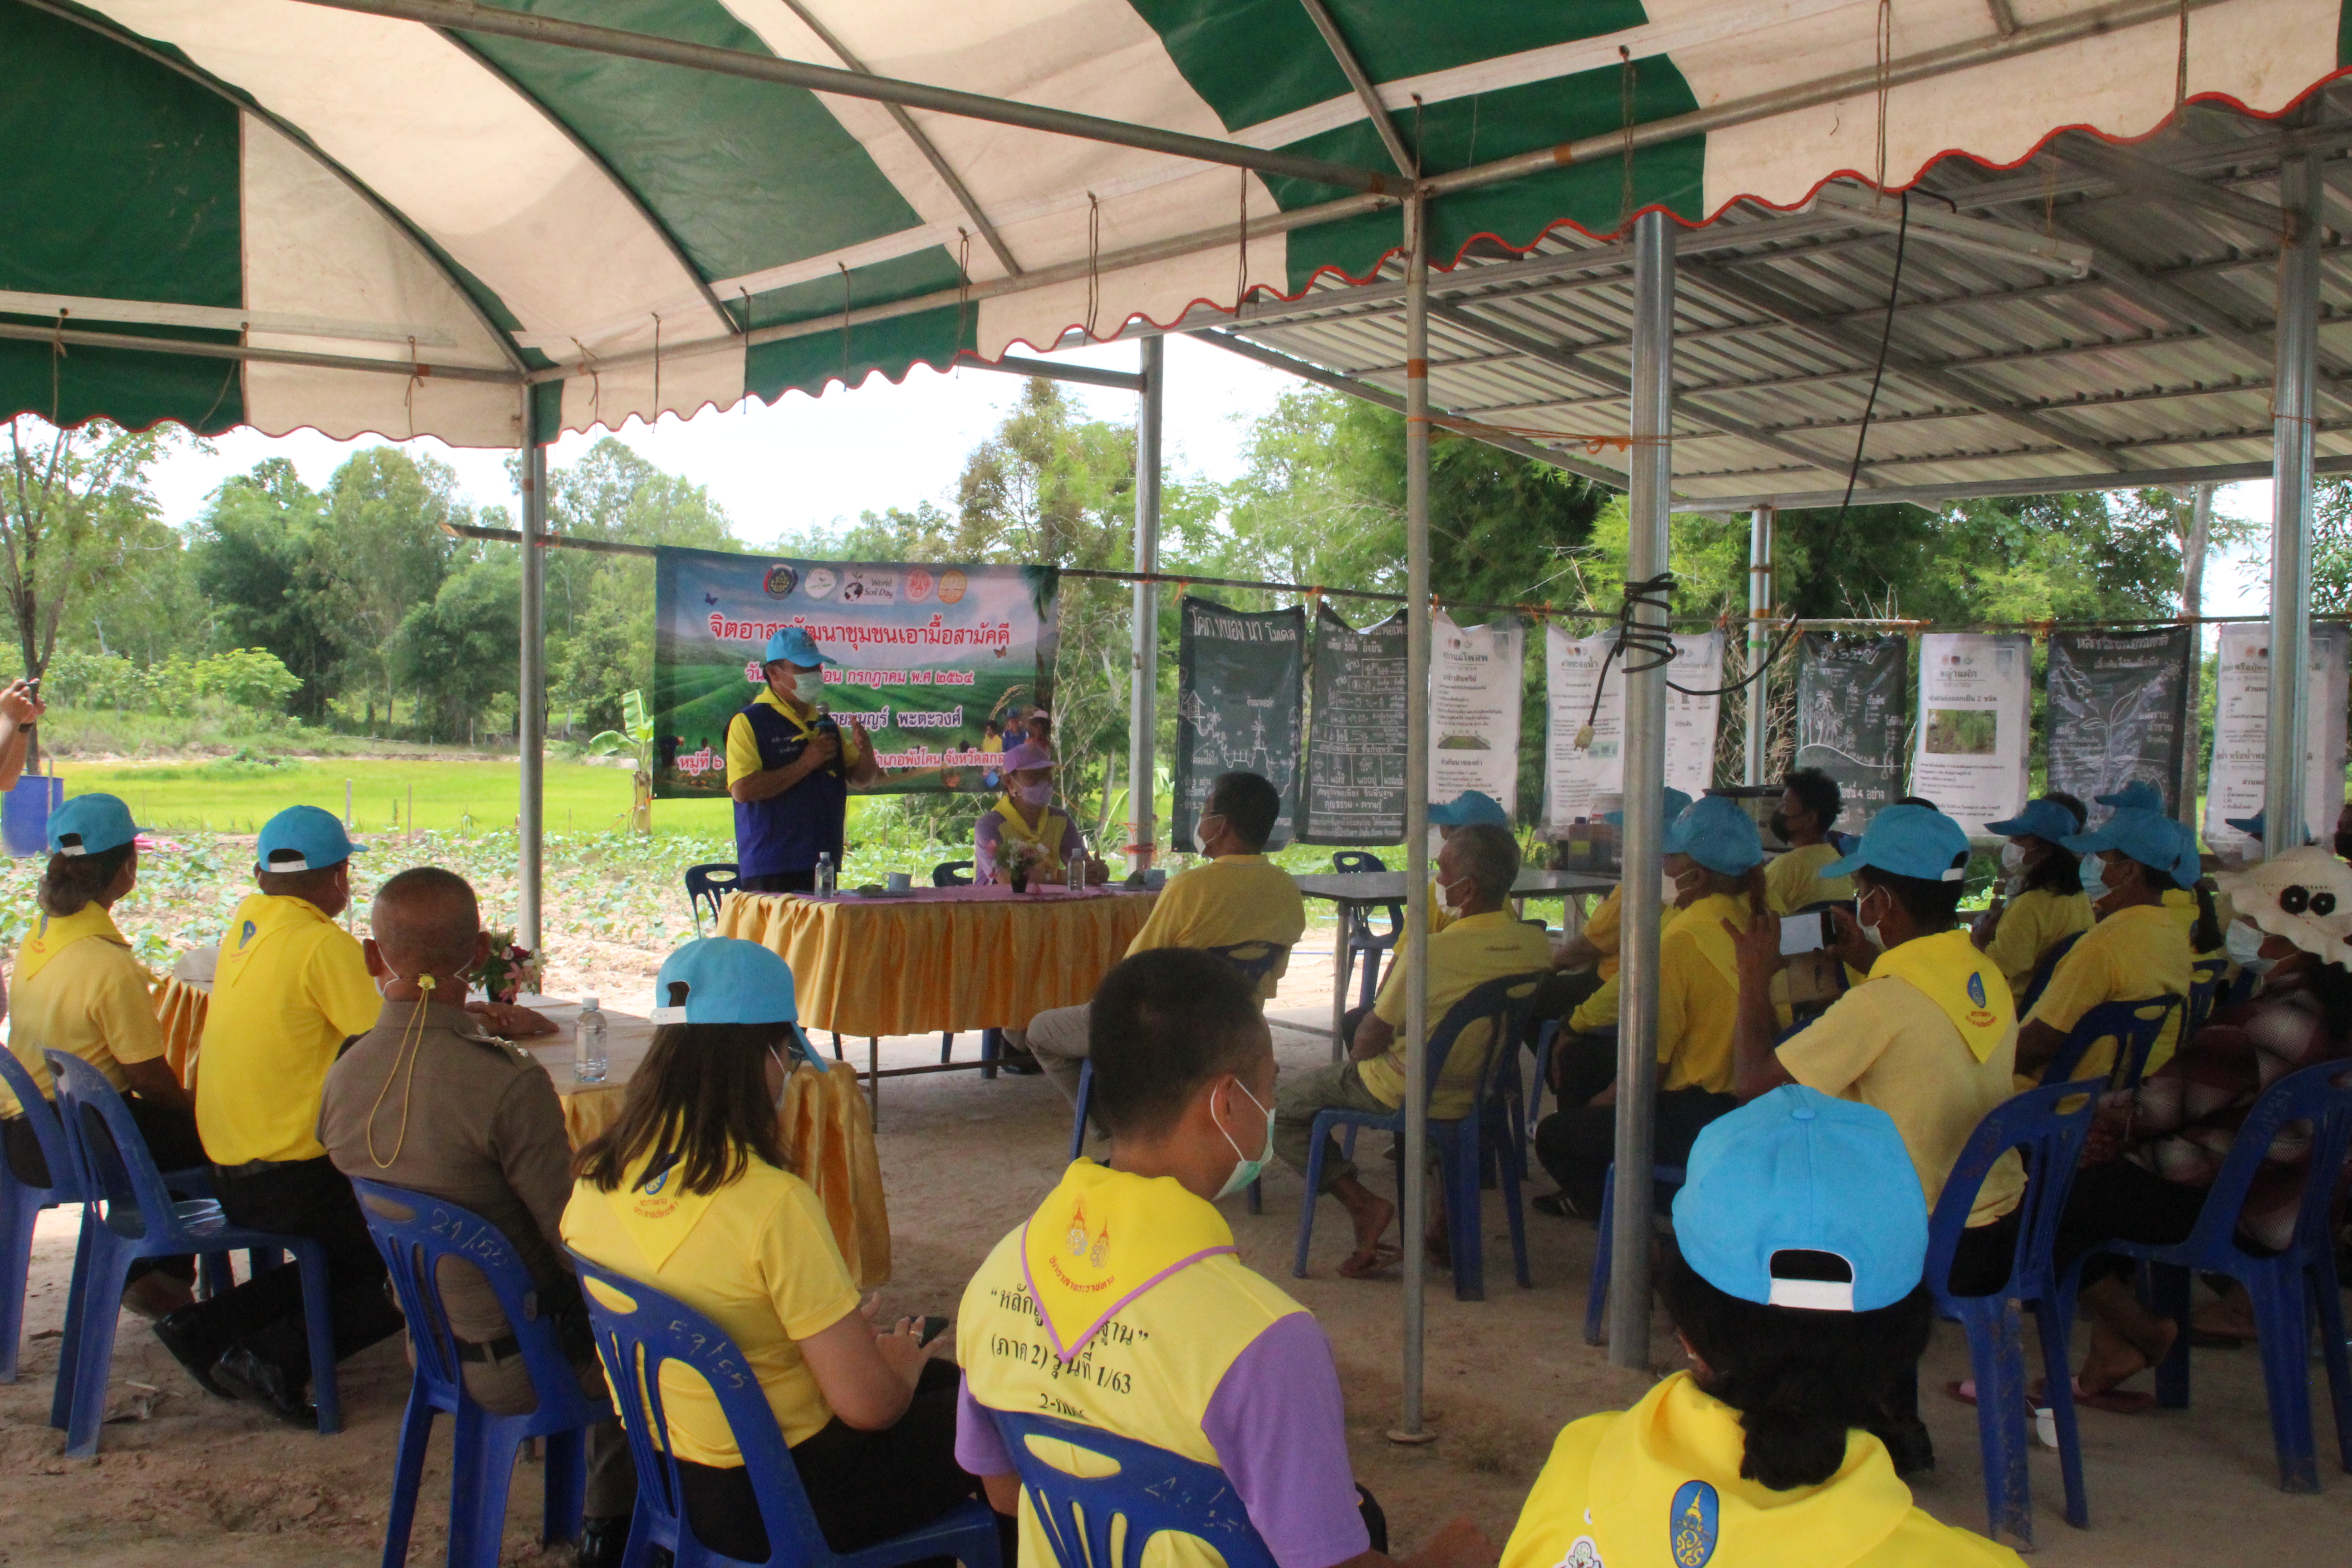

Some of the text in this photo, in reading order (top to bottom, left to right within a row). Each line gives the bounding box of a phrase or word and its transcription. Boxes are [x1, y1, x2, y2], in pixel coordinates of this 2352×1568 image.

[871, 578, 892, 587] World
[864, 587, 893, 599] Soil Day
[710, 614, 1009, 651] จิตอาสัฒนาชุมชนเอามื้อสามัคคี
[1245, 621, 1263, 641] นา
[848, 671, 906, 687] กรกฎาคม
[911, 669, 931, 682] พ.ศ
[936, 671, 973, 683] ๒๕๖๔
[898, 706, 961, 727] พะตะวงศ์
[680, 748, 1004, 774] หมู่ที่ ๖ ำเภอพังโคน จังหวัดสกล
[991, 1333, 1131, 1394] (ภาค 2) รุนที่ 1/63
